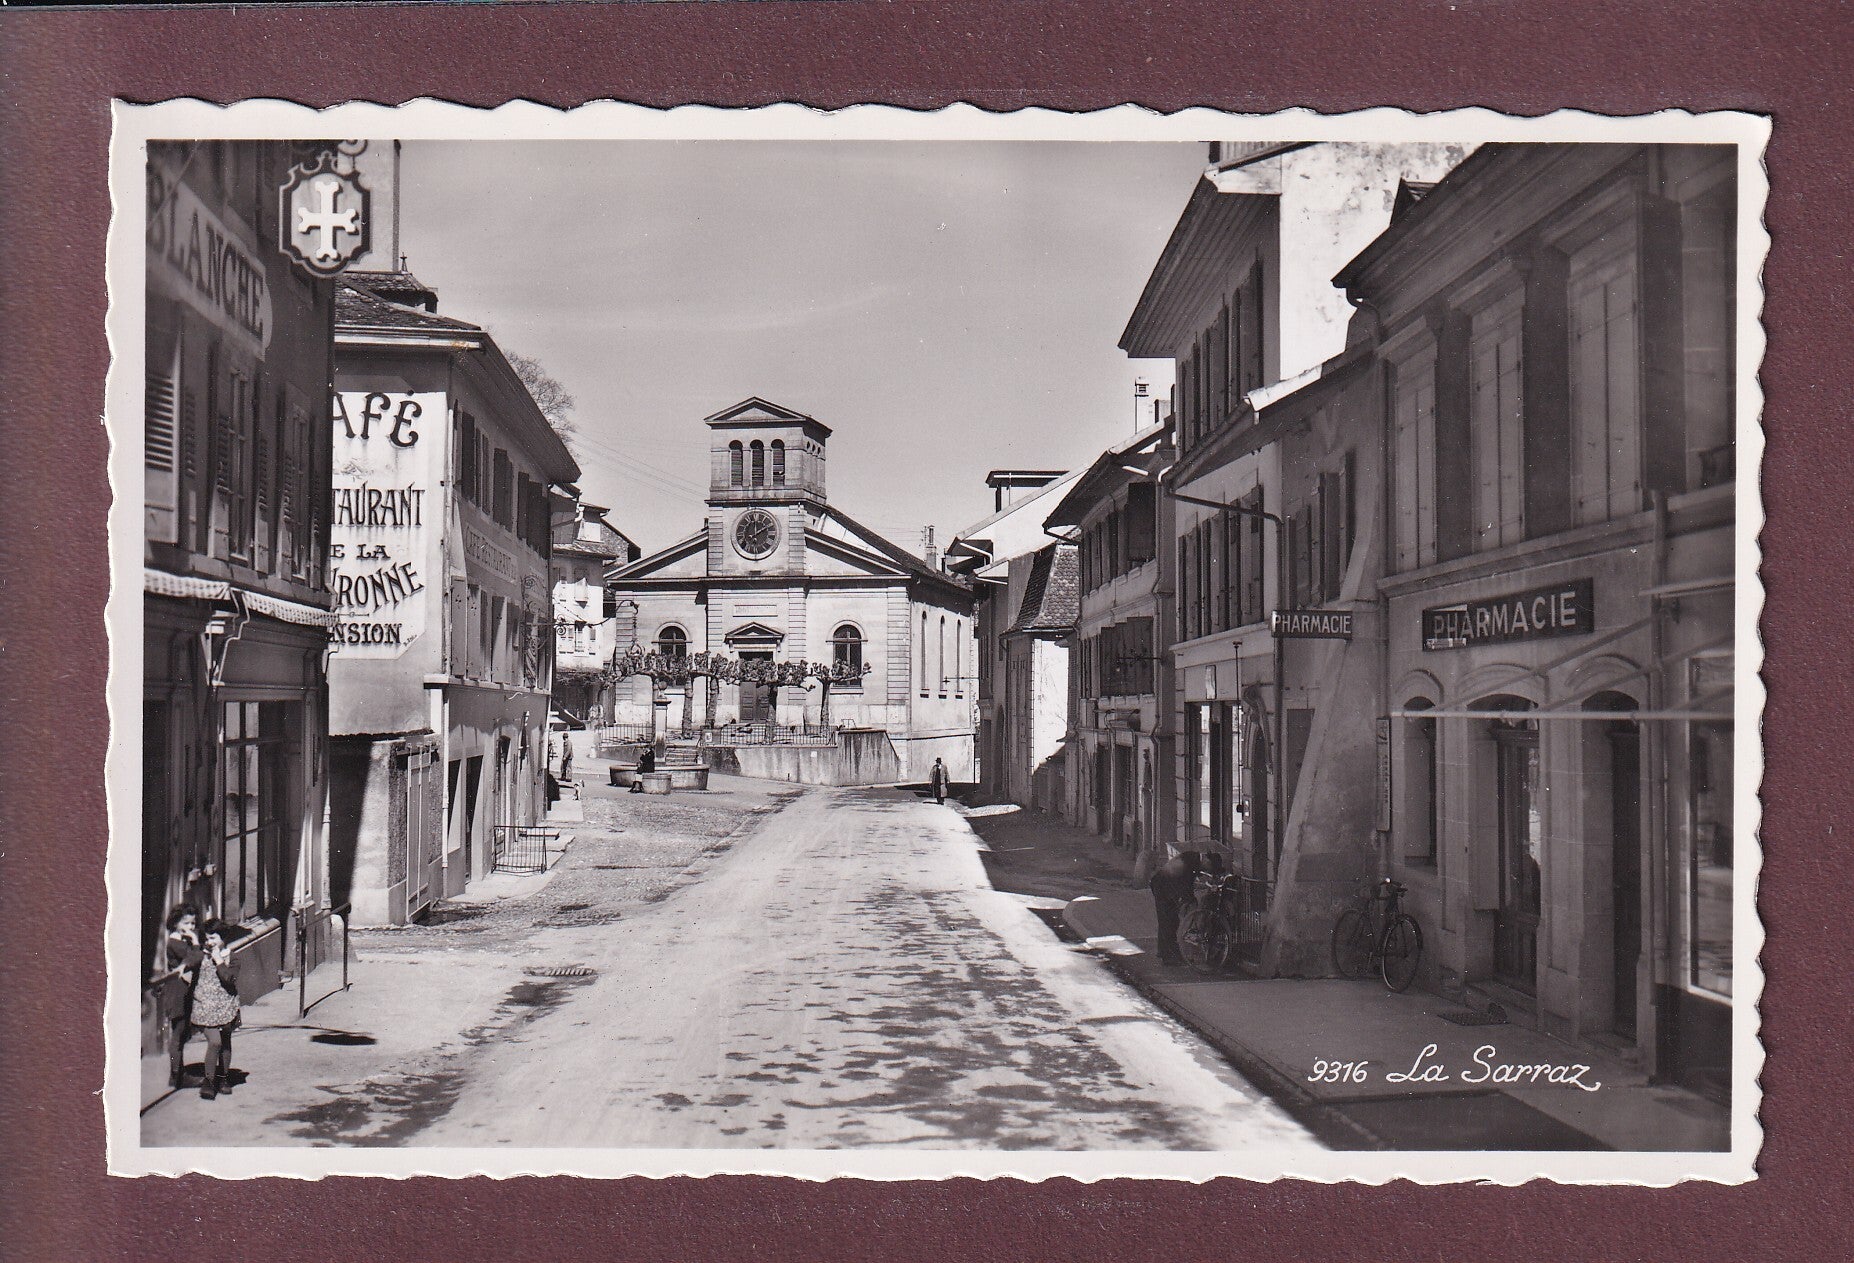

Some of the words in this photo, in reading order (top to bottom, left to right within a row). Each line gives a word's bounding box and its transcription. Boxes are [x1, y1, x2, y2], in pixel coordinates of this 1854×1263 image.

[356, 543, 391, 559] LA
[1273, 613, 1352, 634] PHARMACIE
[1434, 590, 1577, 640] PHARMACIE
[330, 622, 403, 645] NSION
